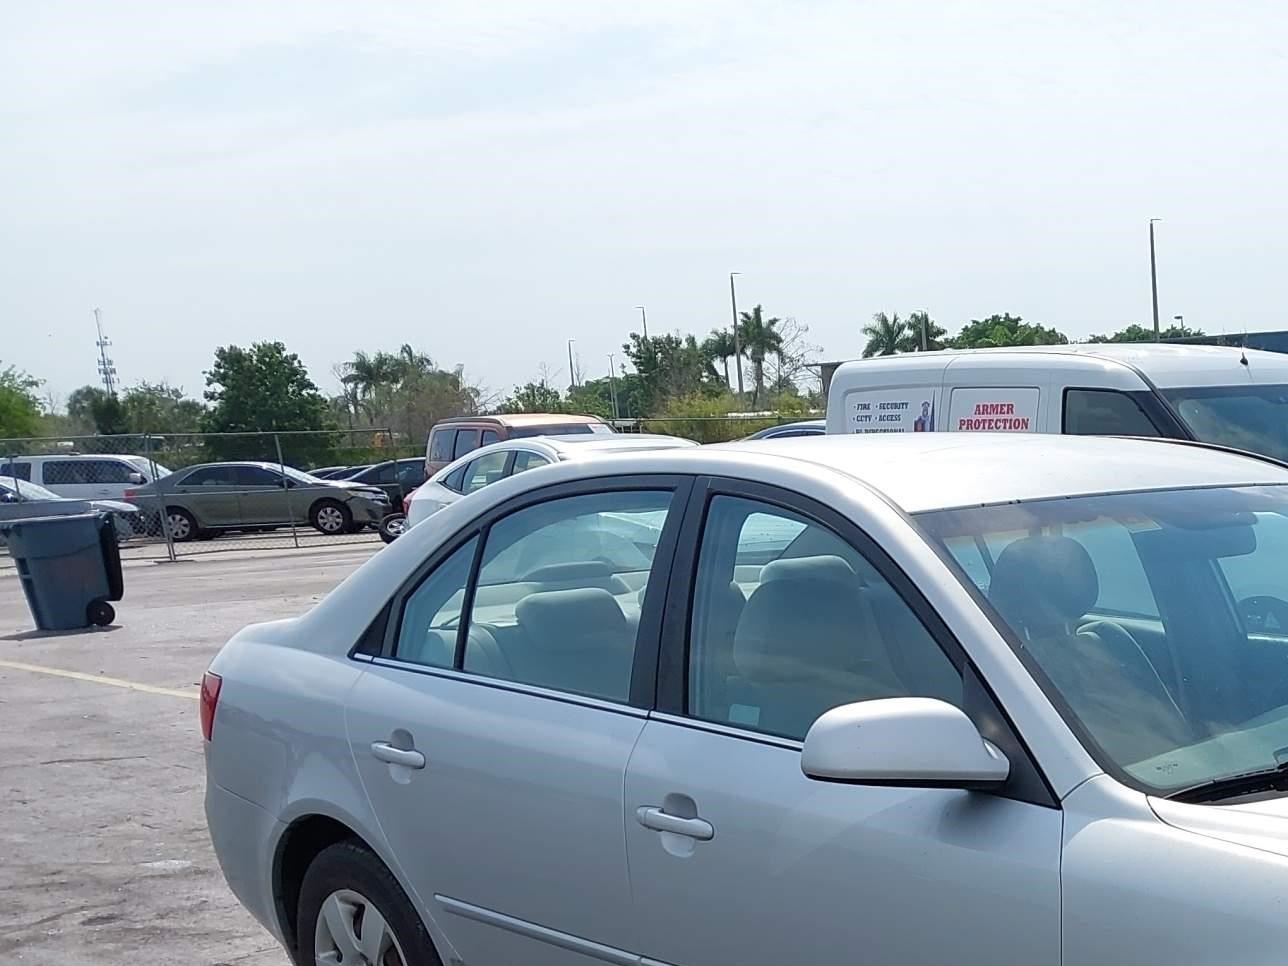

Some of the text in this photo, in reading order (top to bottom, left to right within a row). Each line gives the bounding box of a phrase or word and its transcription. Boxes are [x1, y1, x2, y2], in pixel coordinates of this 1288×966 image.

[856, 402, 909, 411] FIRE SECURITY
[973, 403, 1015, 416] ARMER
[856, 414, 901, 422] CCTV ACCESS
[958, 418, 1030, 431] PROTECTION
